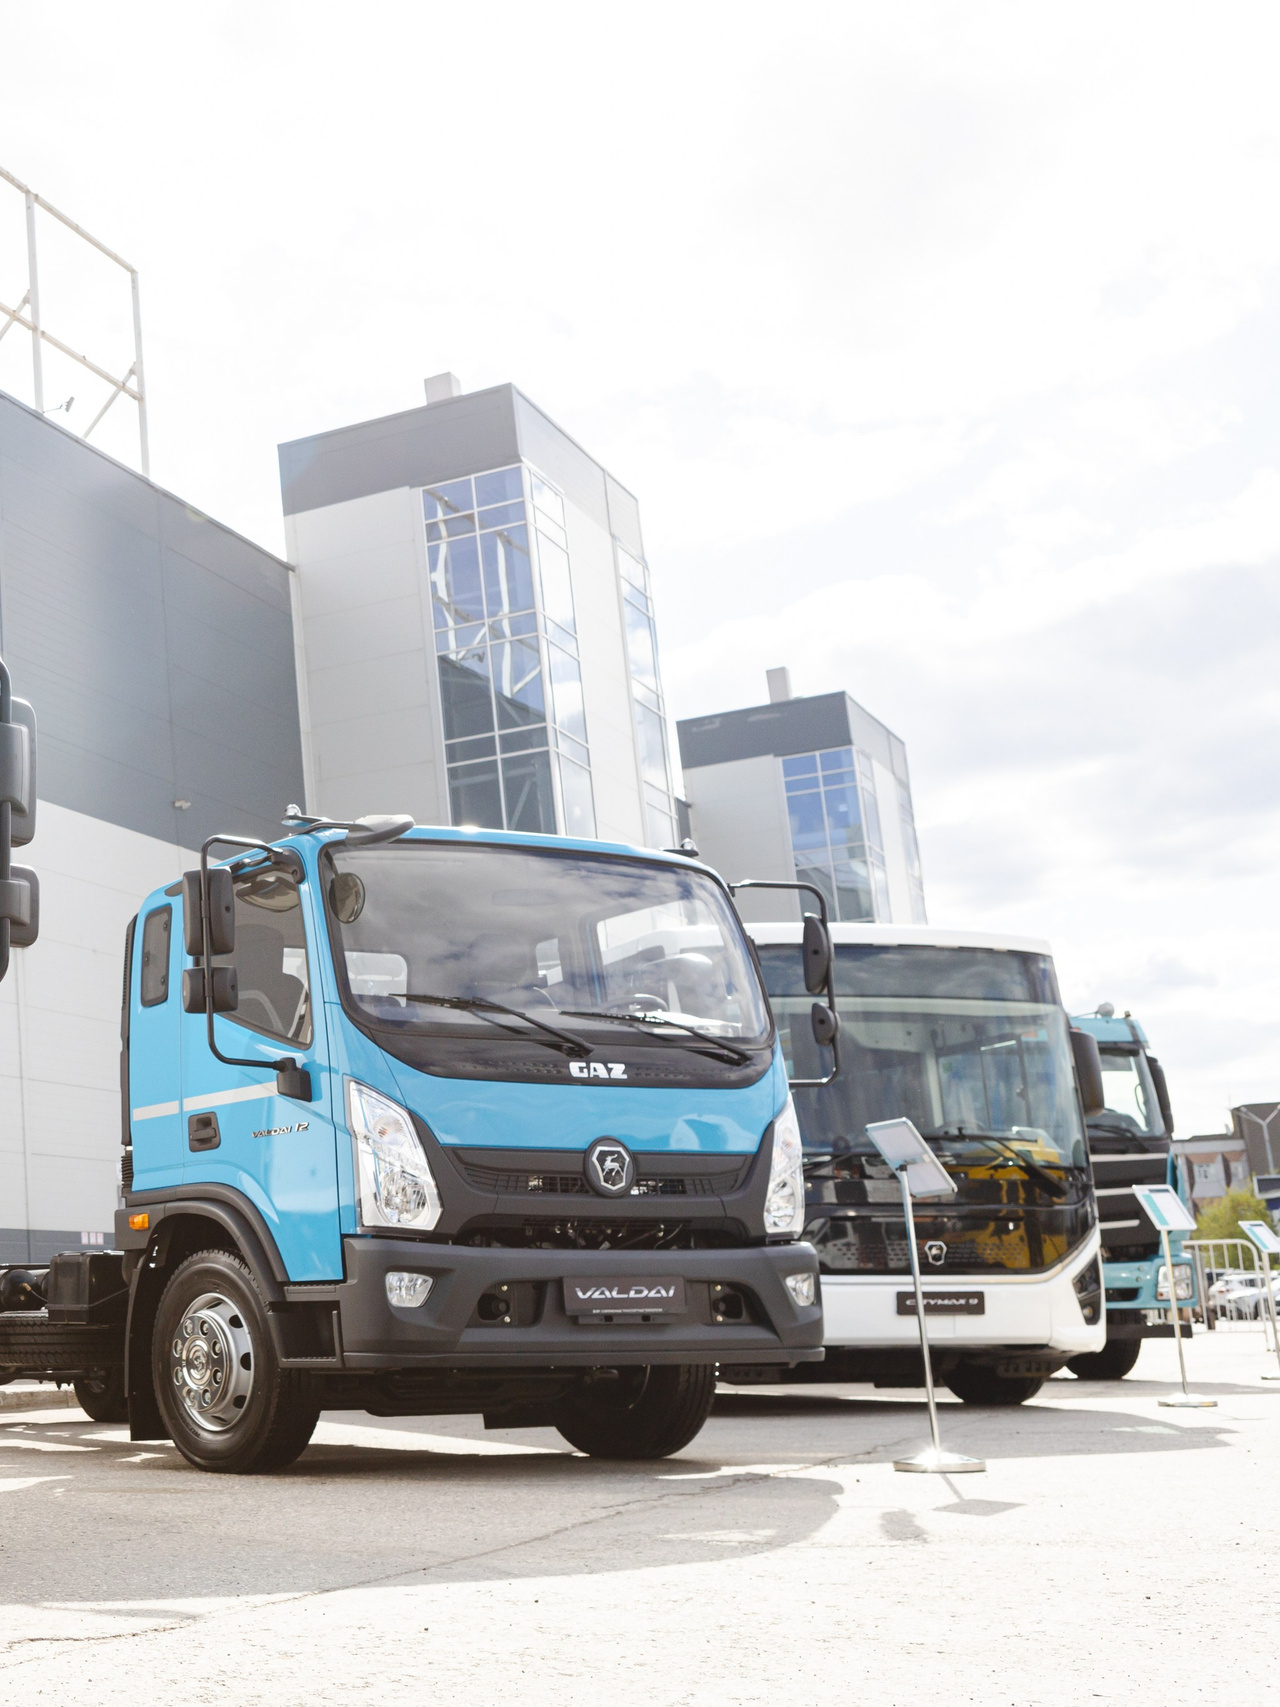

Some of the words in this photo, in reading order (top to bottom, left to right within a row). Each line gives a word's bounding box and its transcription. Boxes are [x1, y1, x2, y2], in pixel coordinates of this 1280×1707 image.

[568, 1061, 628, 1079] GAZ
[251, 1126, 292, 1138] VALDAI
[294, 1121, 310, 1132] 12
[574, 1286, 676, 1299] VALDAI
[905, 1298, 967, 1306] CTYMAX
